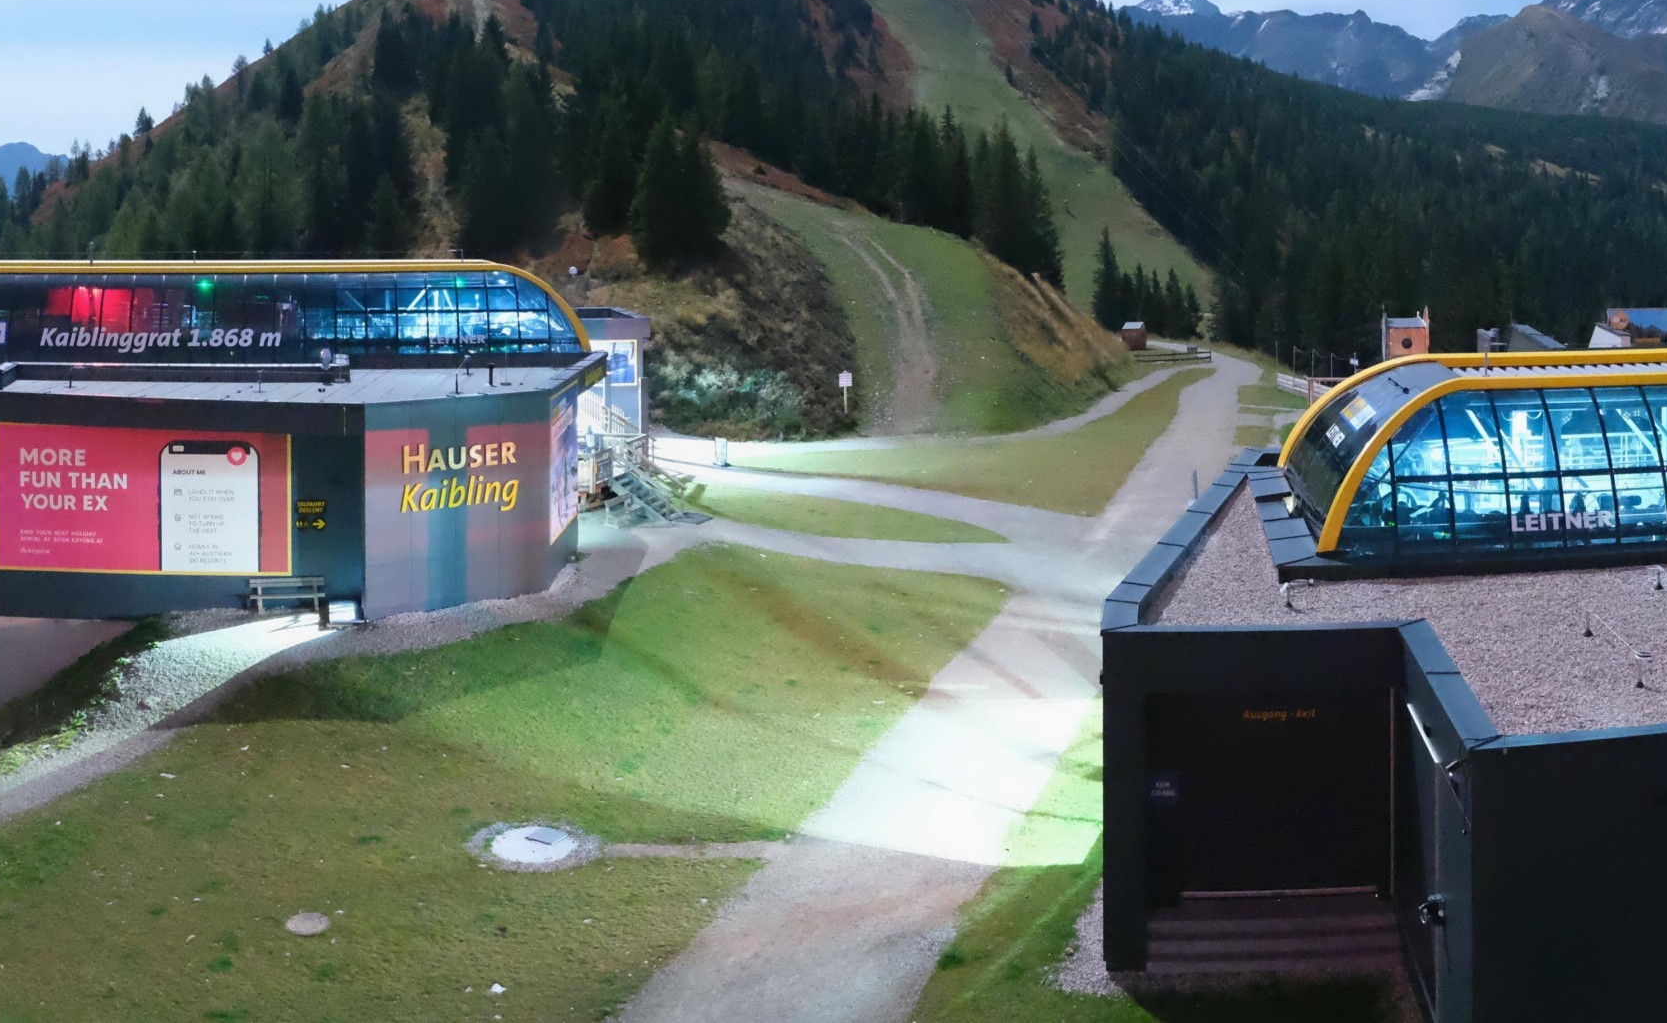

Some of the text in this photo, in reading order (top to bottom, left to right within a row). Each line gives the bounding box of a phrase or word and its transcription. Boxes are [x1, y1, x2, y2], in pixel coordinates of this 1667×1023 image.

[40, 327, 281, 354] Kaiblinggrat 1.868 m
[429, 334, 486, 345] LEITNER
[20, 448, 86, 466] MORE
[402, 441, 518, 474] HAUSER
[19, 470, 128, 490] FUN THAN
[21, 493, 108, 511] YOUR EX
[399, 475, 519, 514] Kaibling
[1511, 509, 1613, 532] LEITNER
[1242, 708, 1288, 721] Ausgang
[1296, 708, 1316, 718] Exit
